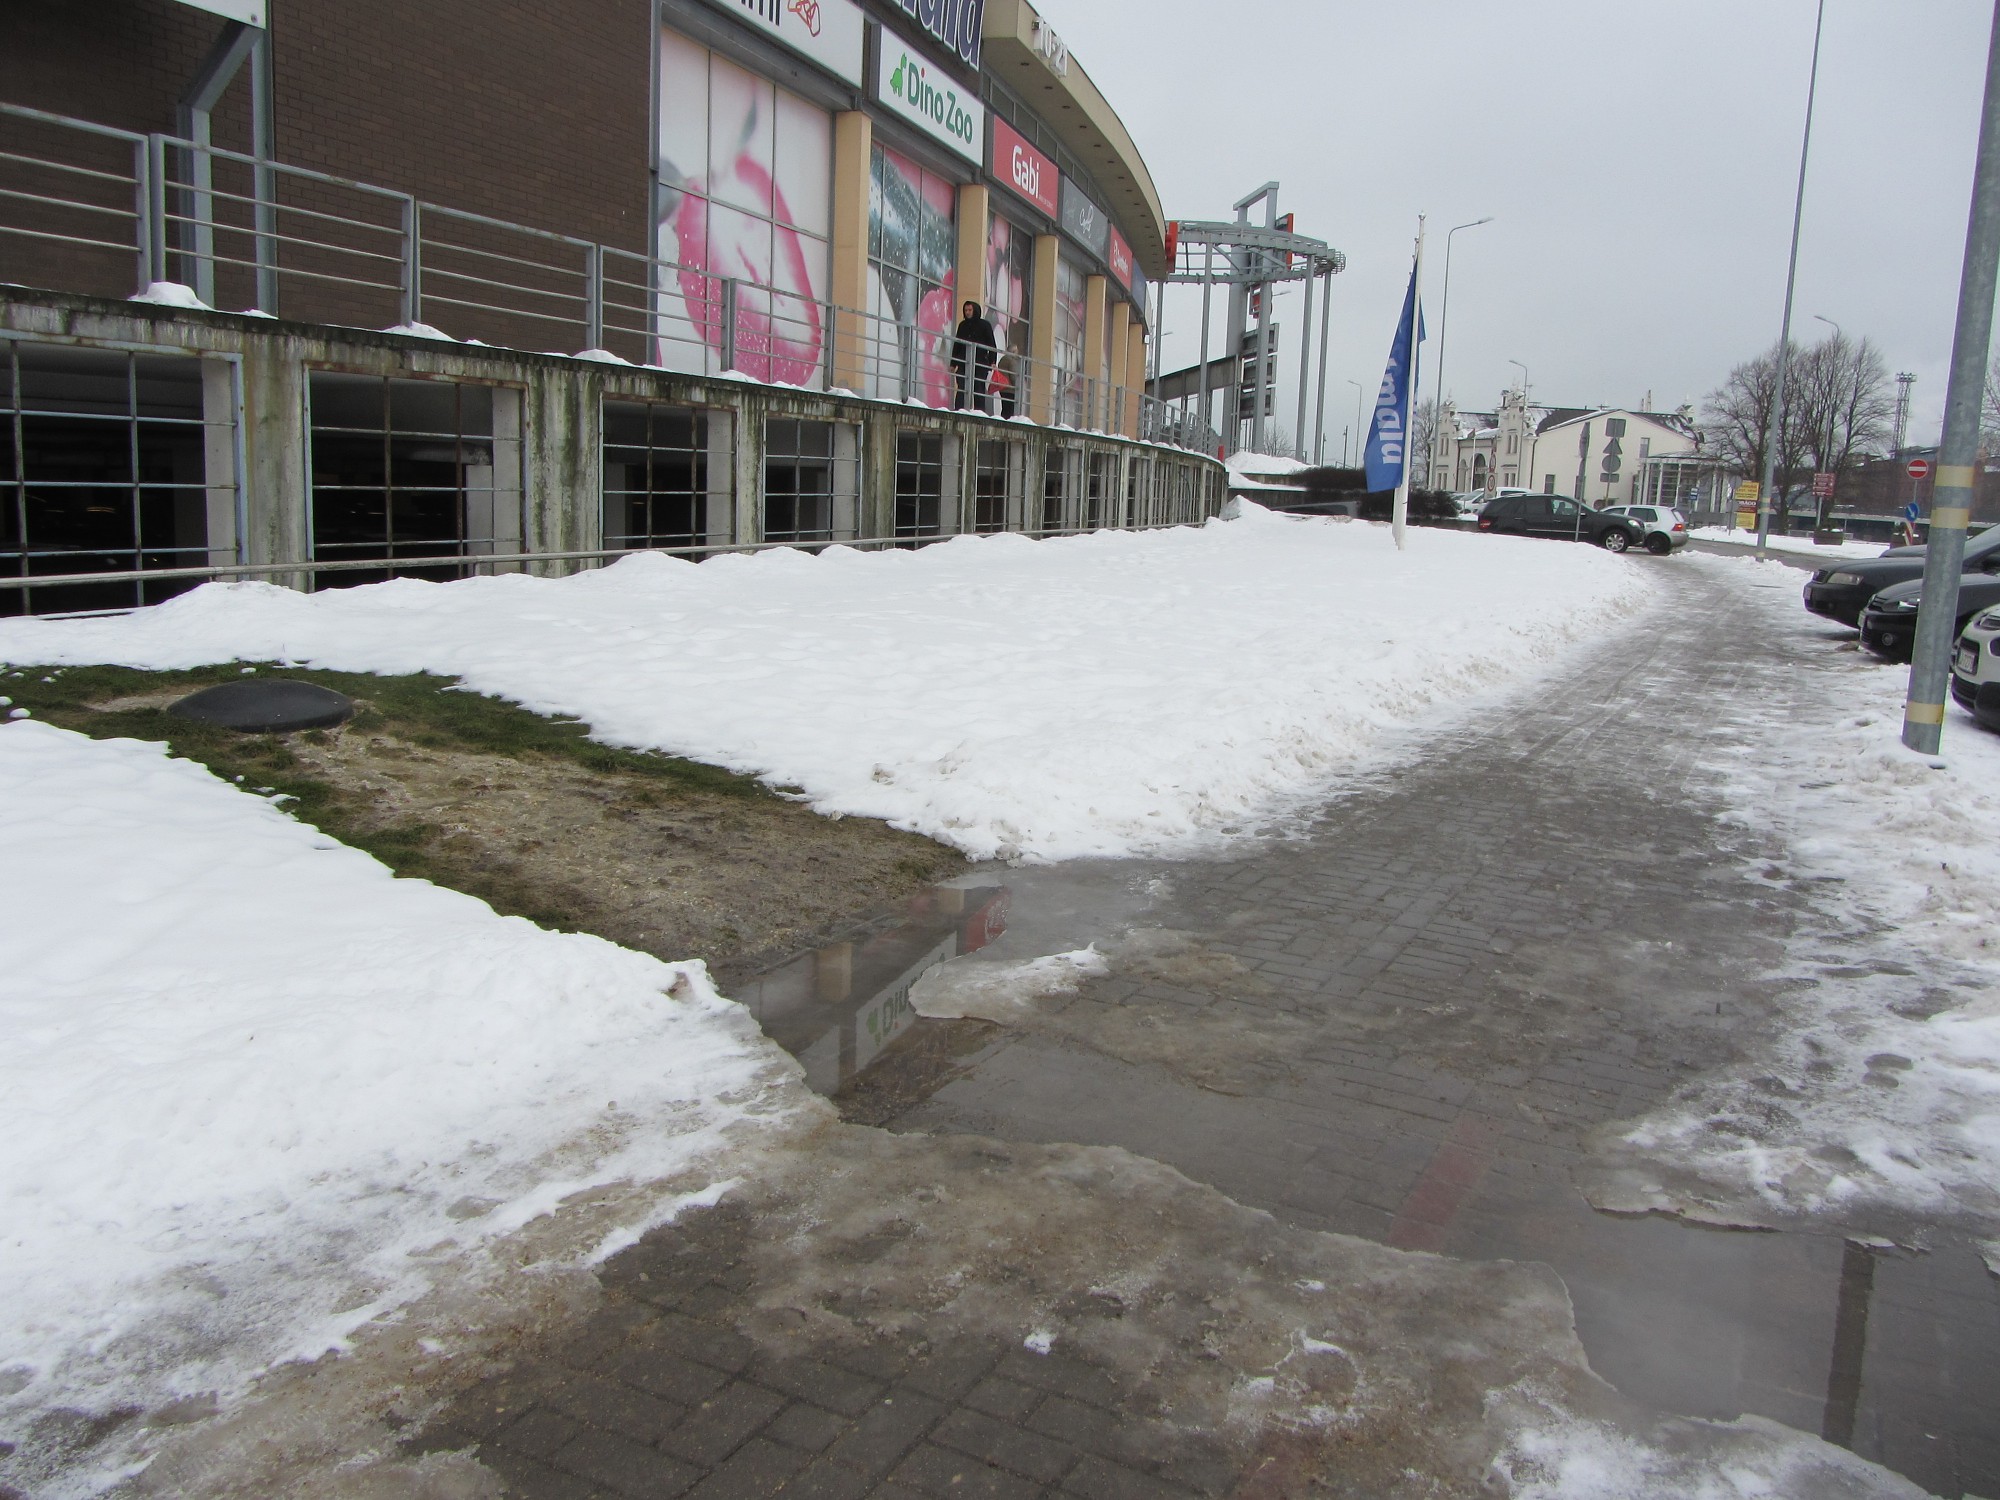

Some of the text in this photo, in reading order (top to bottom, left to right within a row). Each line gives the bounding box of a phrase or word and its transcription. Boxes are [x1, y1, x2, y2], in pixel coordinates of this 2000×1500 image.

[908, 62, 973, 144] Dino Zoo
[1012, 145, 1040, 199] Gabi
